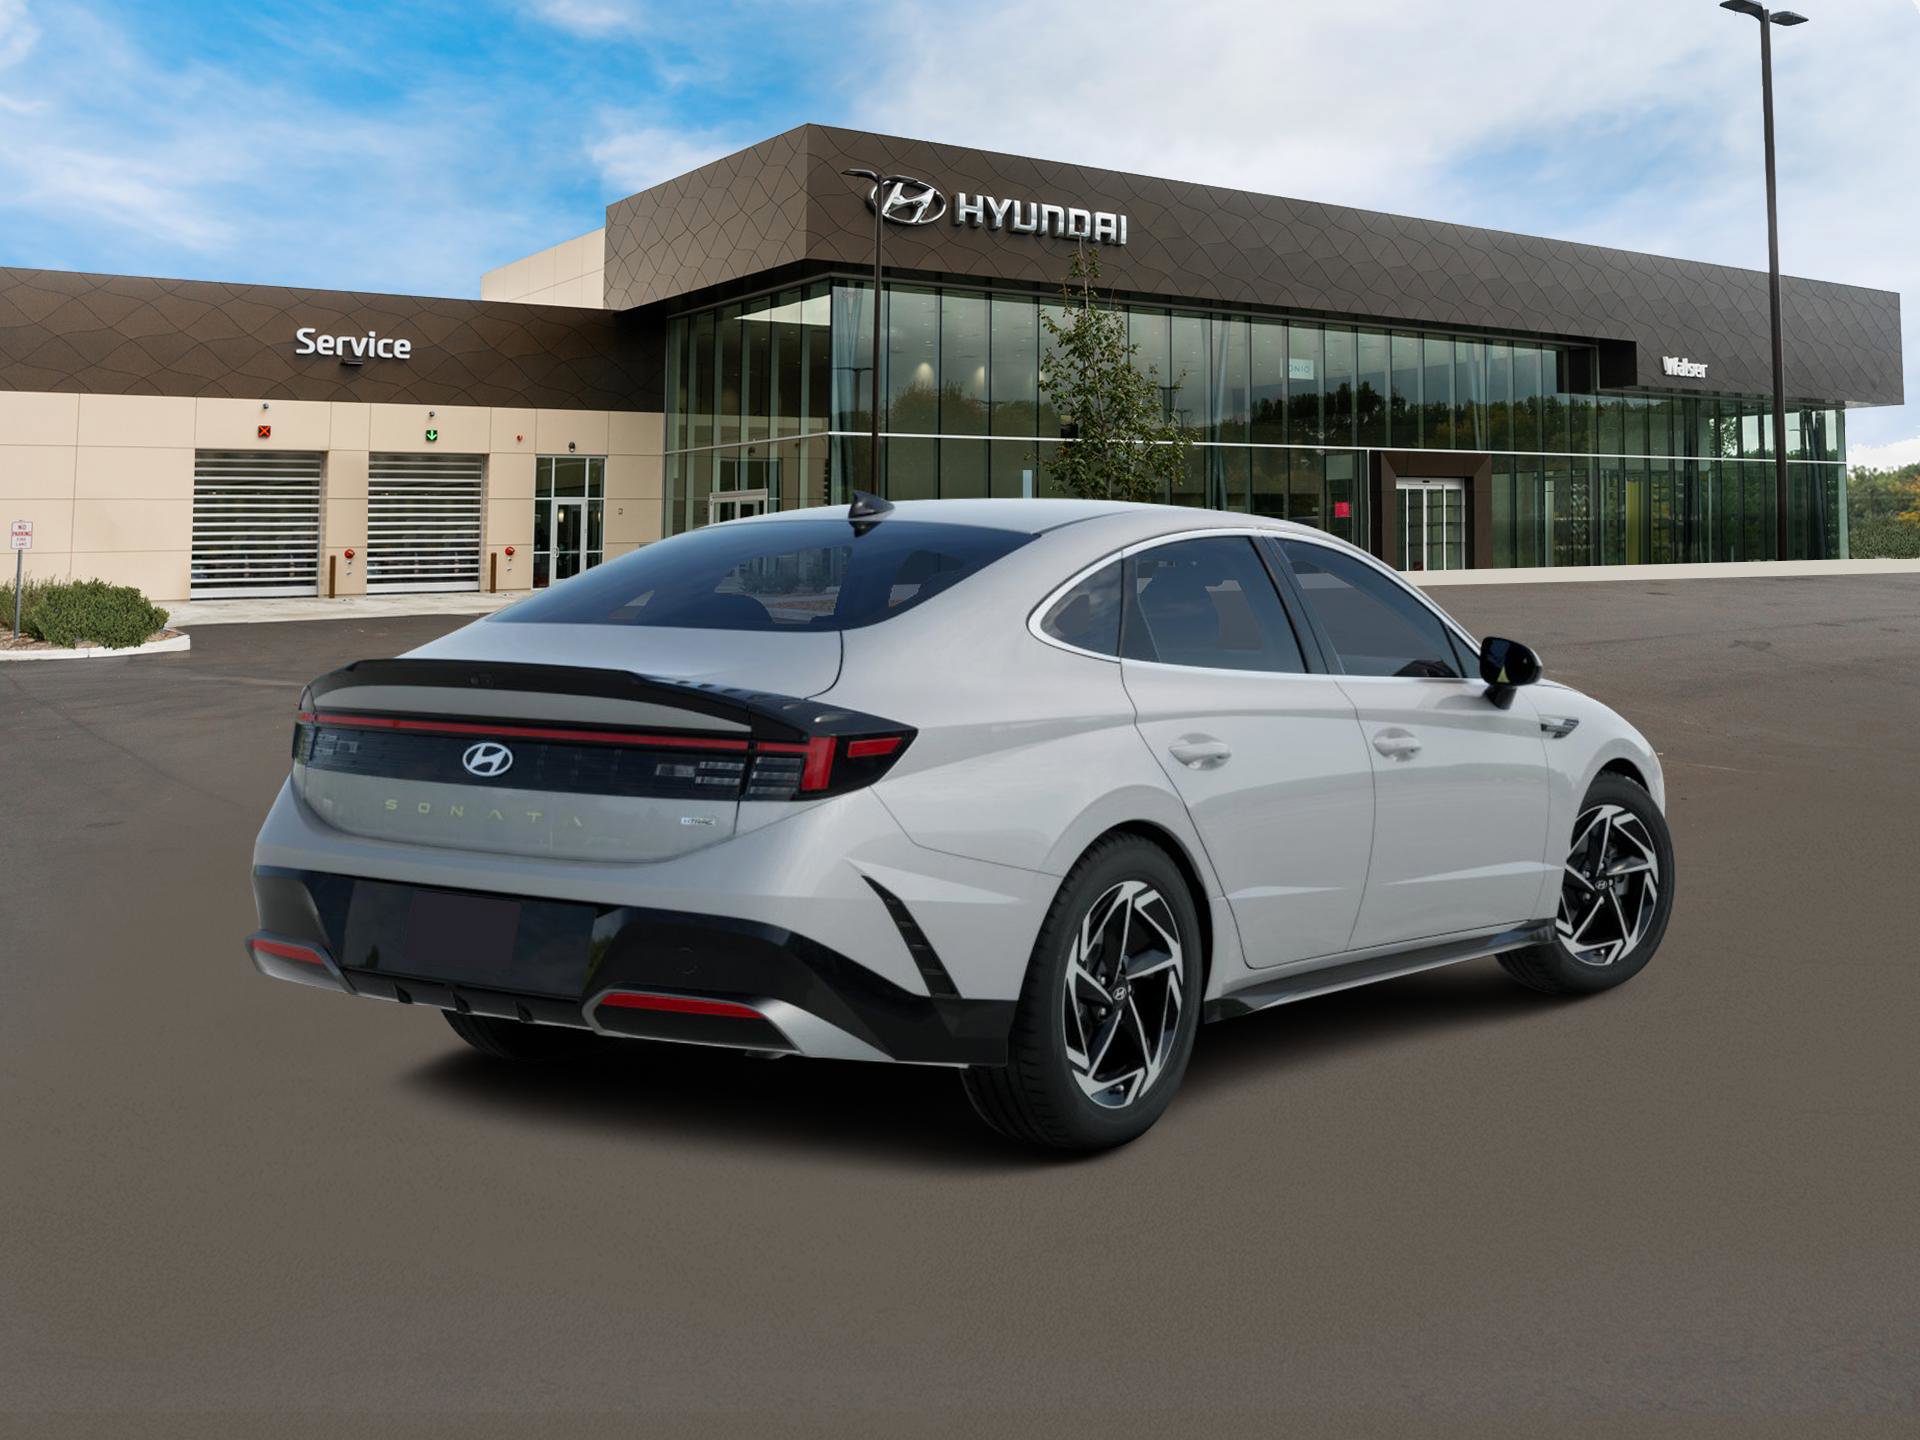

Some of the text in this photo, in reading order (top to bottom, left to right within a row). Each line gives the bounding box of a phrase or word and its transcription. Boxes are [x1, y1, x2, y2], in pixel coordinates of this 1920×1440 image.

[956, 192, 1127, 245] HYUNDAI
[296, 327, 411, 359] Service
[1663, 356, 1708, 378] Walser
